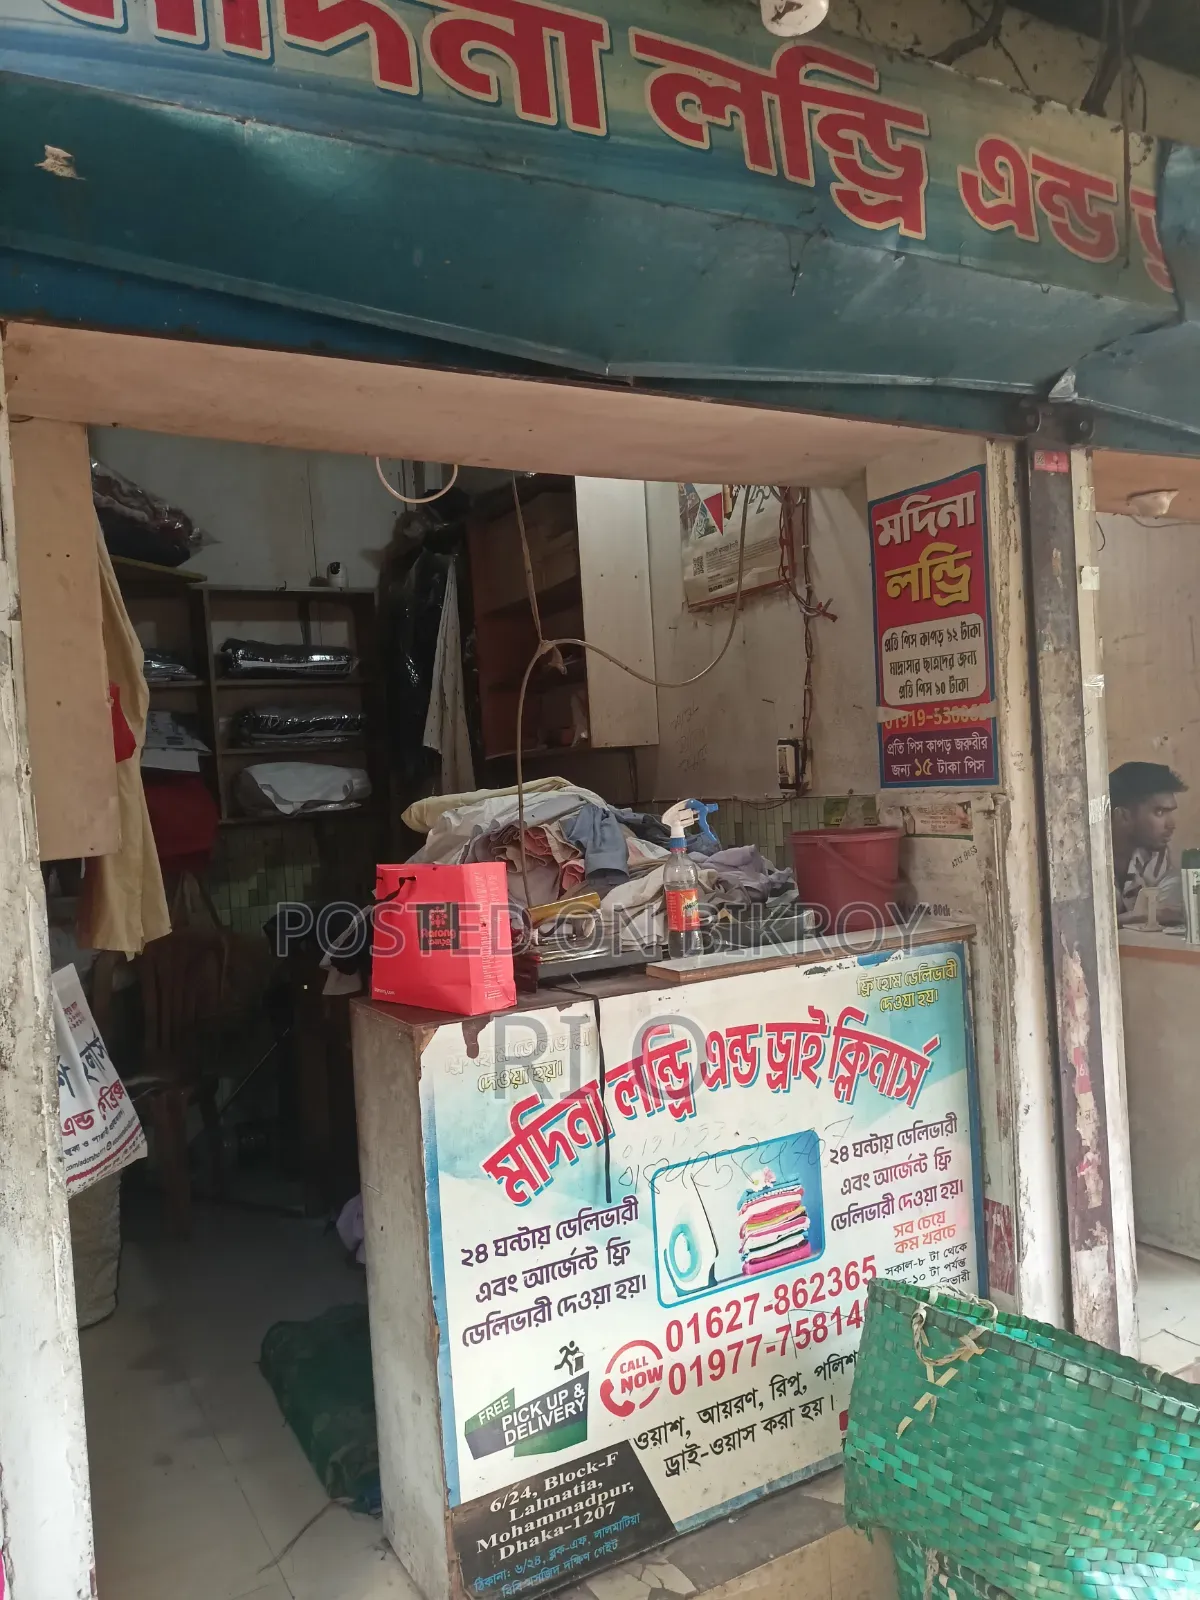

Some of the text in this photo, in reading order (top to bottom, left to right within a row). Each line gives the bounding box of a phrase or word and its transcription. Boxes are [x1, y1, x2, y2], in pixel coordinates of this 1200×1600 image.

[628, 39, 929, 240] লন্ড্রি
[957, 134, 1120, 263] এন্ড
[876, 491, 976, 546] মদিনা
[884, 542, 972, 607] লন্ড্রি
[884, 621, 981, 653] প্রতি পিস কাপড় ১২ টাকা
[957, 650, 977, 669] জন্য
[899, 675, 969, 699] প্রতি পিস ১০ টাকা
[887, 738, 905, 756] প্রতি
[907, 737, 923, 754] পিস
[926, 739, 951, 755] কাপড়
[891, 756, 985, 777] জন্য ১৫ টাকা পিস
[876, 971, 903, 991] হোম
[904, 958, 957, 987] ডেলিভারী
[481, 1079, 615, 1207] মদিনা
[604, 1024, 697, 1122] লন্ড্রি
[700, 1023, 763, 1091] এন্ড
[765, 1004, 829, 1093] ড্রাই
[830, 1146, 849, 1164] ২৪
[897, 1112, 958, 1146] ডেলিভারী
[841, 1172, 870, 1195] এবং
[831, 1192, 895, 1231] ডেলিভারী
[893, 1220, 914, 1238] সব
[461, 1243, 489, 1267] ২৪
[555, 1195, 639, 1240] ডেলিভারী
[894, 1224, 956, 1254] কম খরচে
[929, 1251, 939, 1262] টা
[943, 1242, 967, 1258] থেকে
[475, 1274, 518, 1303] এবং
[929, 1266, 940, 1277] টা
[462, 1295, 552, 1347] ডেলিভারী
[666, 1254, 877, 1353] 01627-862365
[668, 1297, 869, 1396] 01977-75814
[620, 1356, 649, 1375] CALL
[620, 1365, 664, 1394] NOW
[478, 1395, 511, 1426] FREE
[501, 1382, 586, 1431] PICK UP &
[504, 1396, 586, 1446] DELIVERY
[761, 1408, 794, 1434] করা
[490, 1451, 619, 1513] 6/24, Block-F
[509, 1478, 603, 1522] Lalmatia,
[476, 1481, 634, 1553] Mohammadpur,
[499, 1501, 616, 1561] Dhaka-1207
